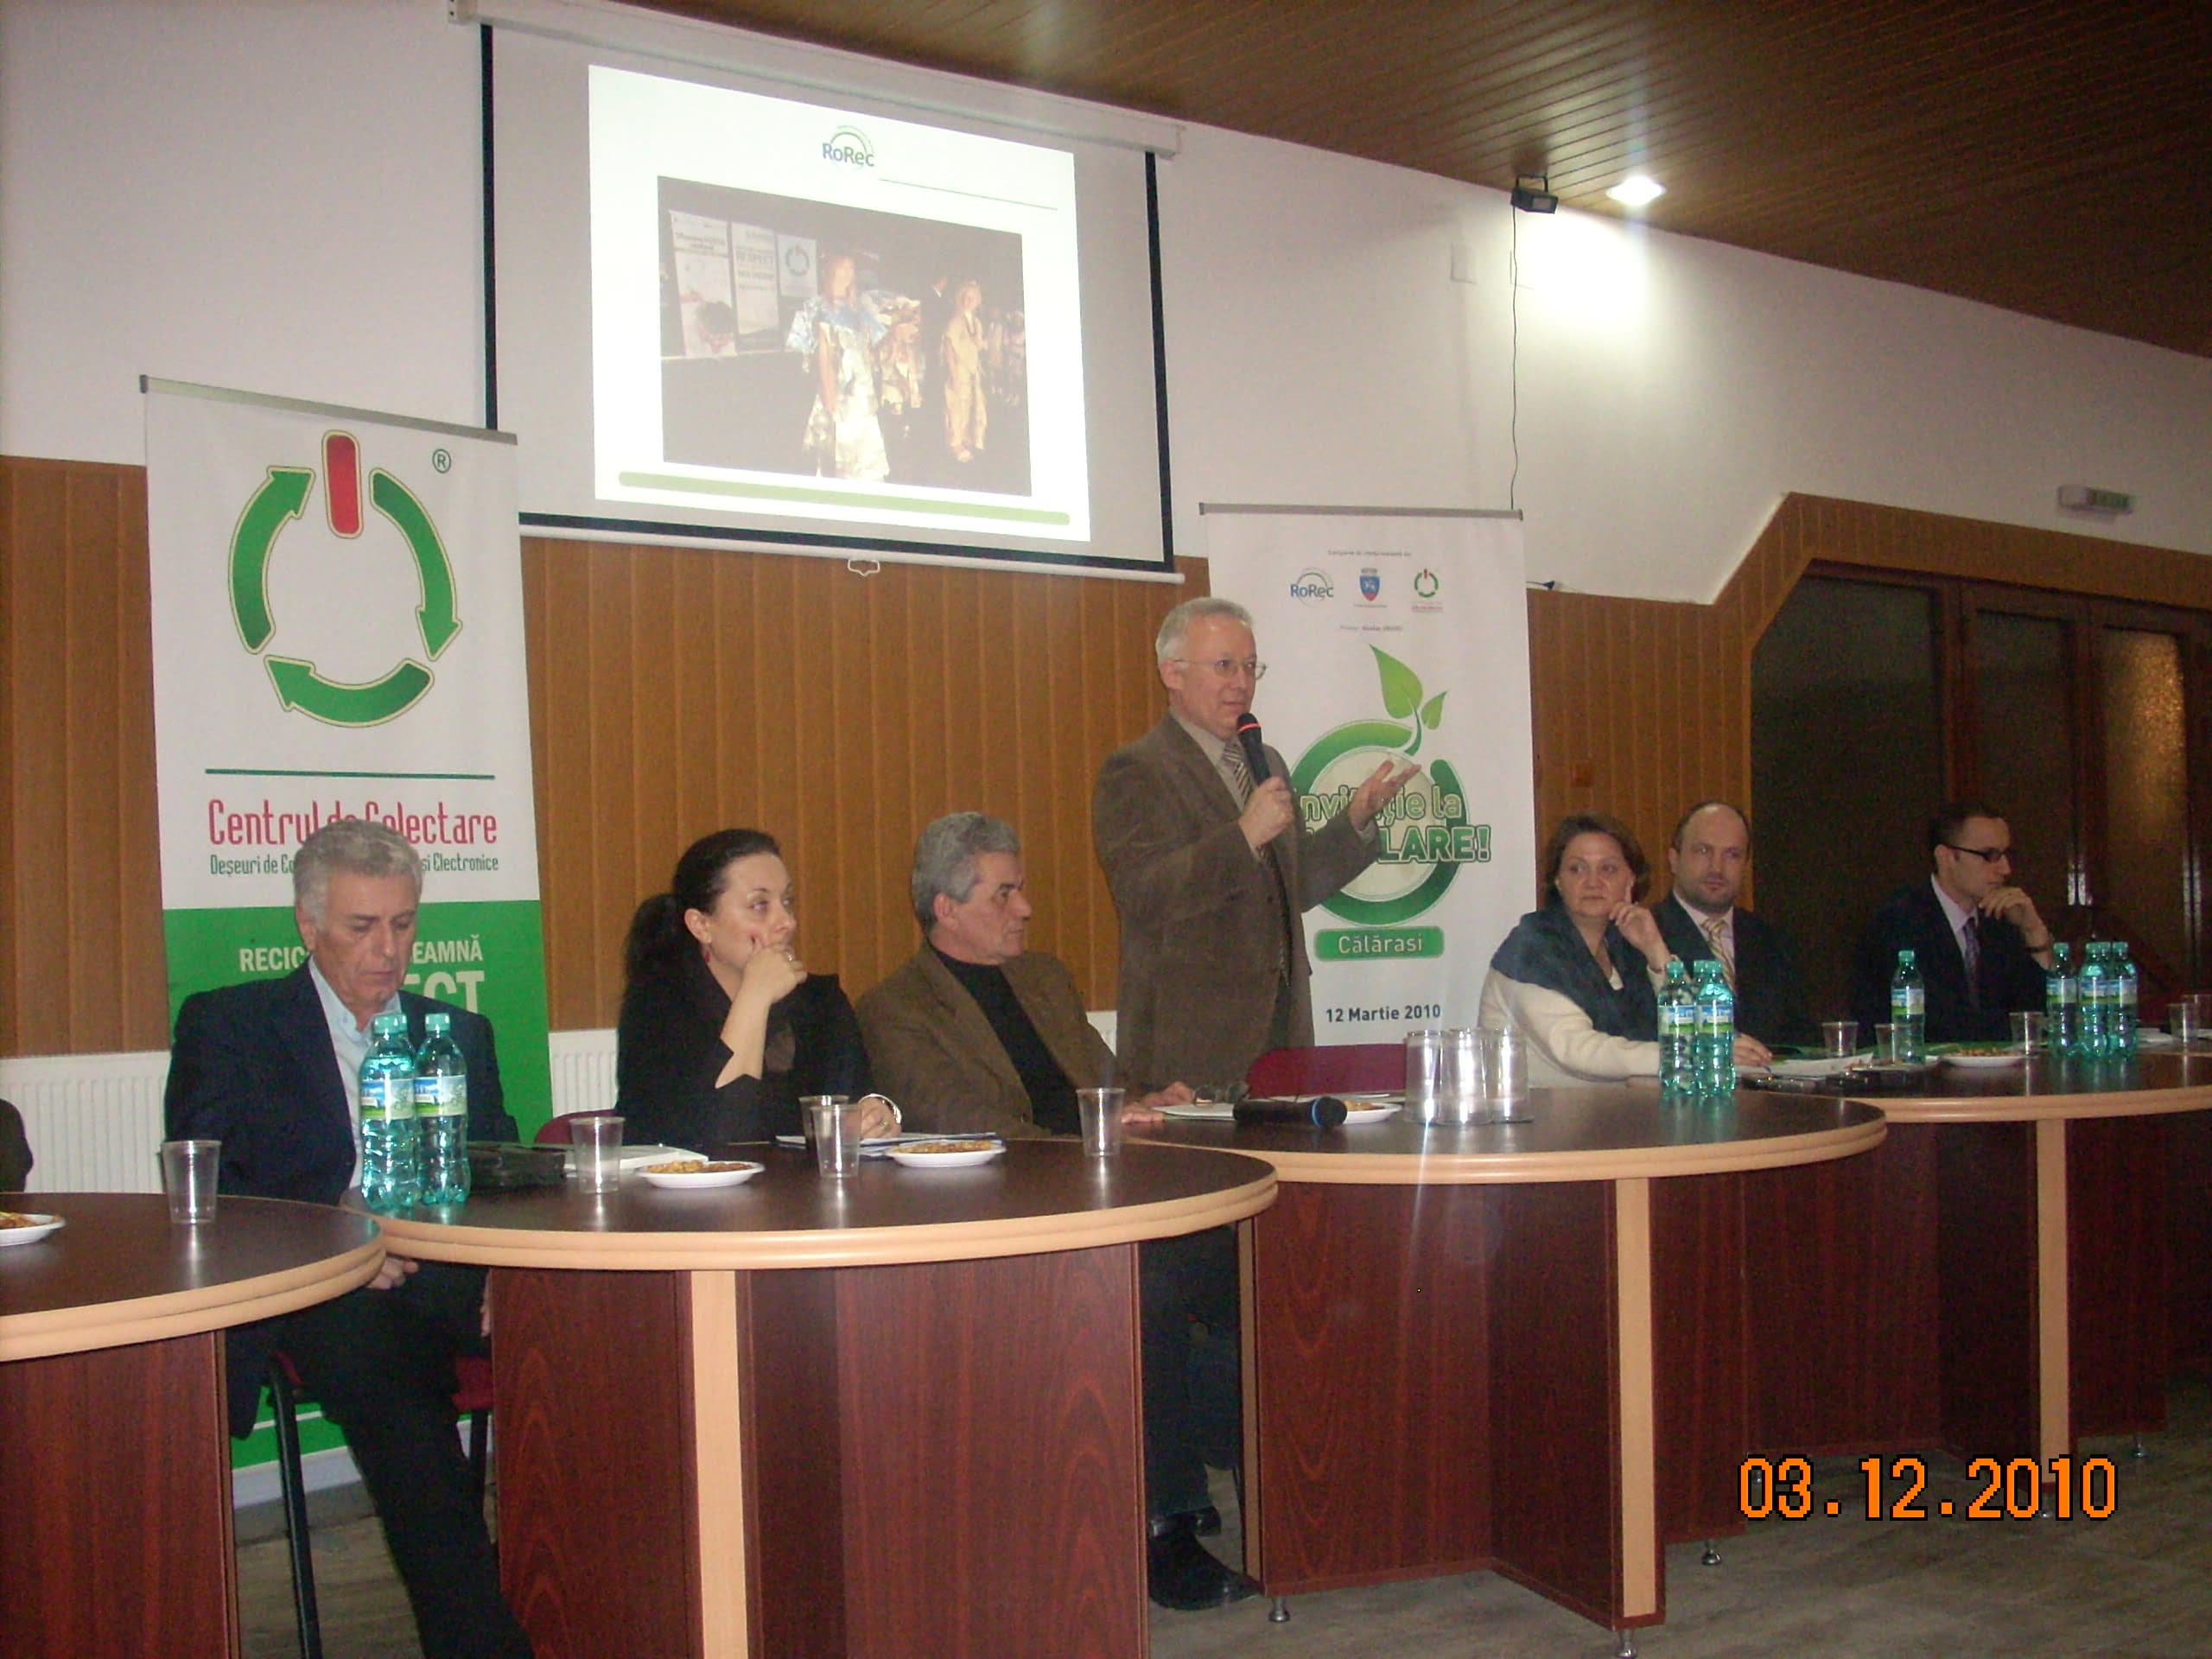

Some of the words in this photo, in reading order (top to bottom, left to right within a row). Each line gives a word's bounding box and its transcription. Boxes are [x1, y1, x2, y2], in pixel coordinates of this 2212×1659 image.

[823, 143, 874, 167] RoRec
[1290, 582, 1335, 598] RoRec
[1432, 784, 1463, 820] la
[208, 798, 319, 845] Centrul
[1377, 824, 1491, 863] LARE!
[264, 854, 278, 874] de
[239, 946, 310, 972] RECIC
[412, 934, 483, 963] EAMNĂ
[1326, 1008, 1344, 1022] 12
[1349, 1006, 1400, 1022] Martie
[1405, 1004, 1440, 1020] 2010
